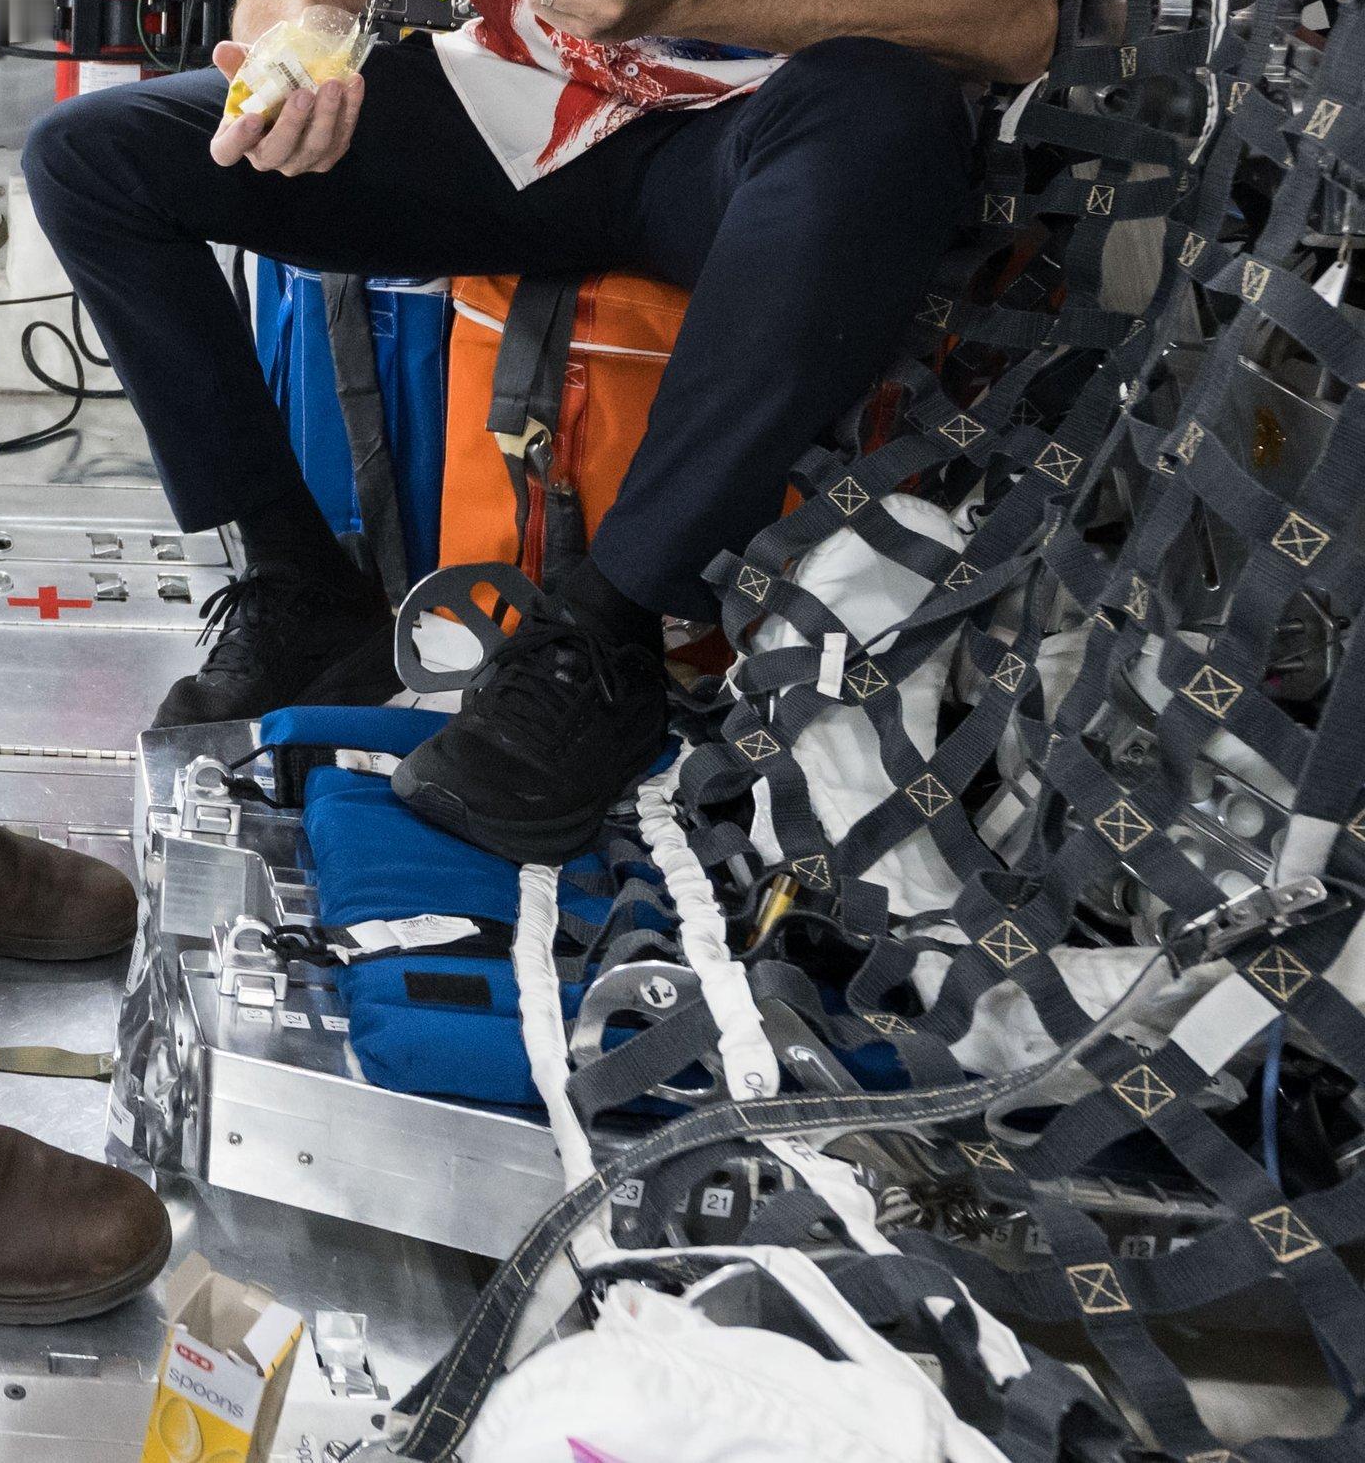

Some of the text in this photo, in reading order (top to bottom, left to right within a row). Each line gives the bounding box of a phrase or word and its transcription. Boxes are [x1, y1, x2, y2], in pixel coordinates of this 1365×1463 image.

[285, 1014, 302, 1024] 12
[328, 1020, 345, 1029] 11
[615, 1183, 639, 1202] 23
[706, 1194, 728, 1210] 21
[1127, 1241, 1151, 1257] 12
[168, 1368, 244, 1418] spoons
